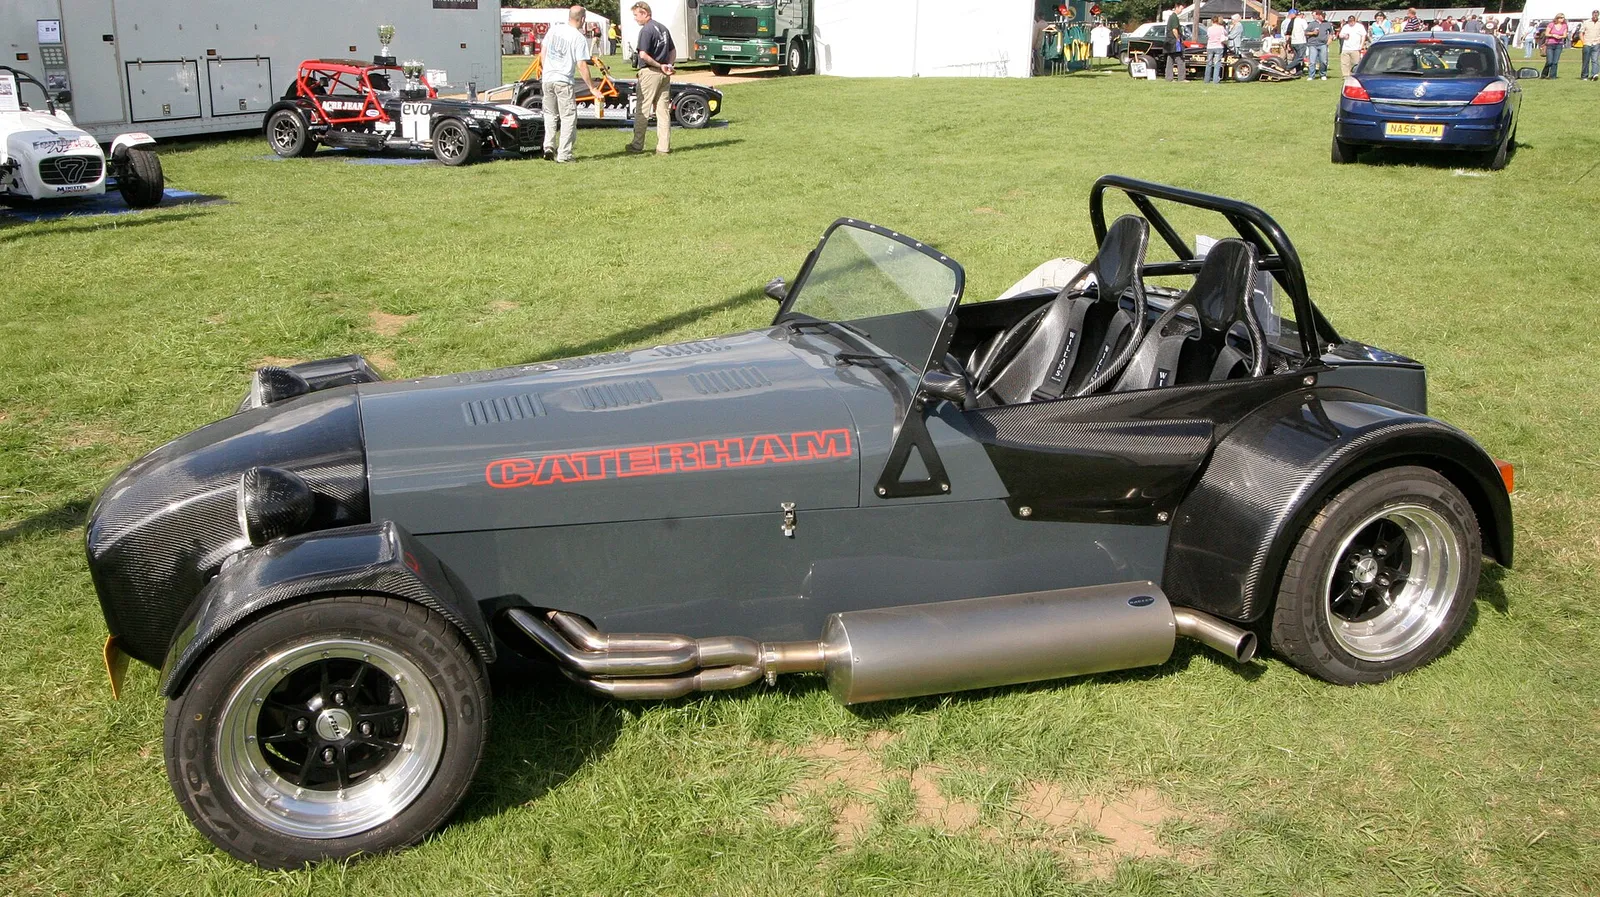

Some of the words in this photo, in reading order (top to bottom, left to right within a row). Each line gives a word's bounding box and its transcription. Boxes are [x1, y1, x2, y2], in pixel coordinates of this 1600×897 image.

[402, 103, 430, 115] evo
[1390, 124, 1416, 133] NA56
[1419, 125, 1438, 134] XJM
[59, 159, 85, 182] 7
[1055, 331, 1076, 378] WILLANS
[485, 428, 852, 489] CATERHAM
